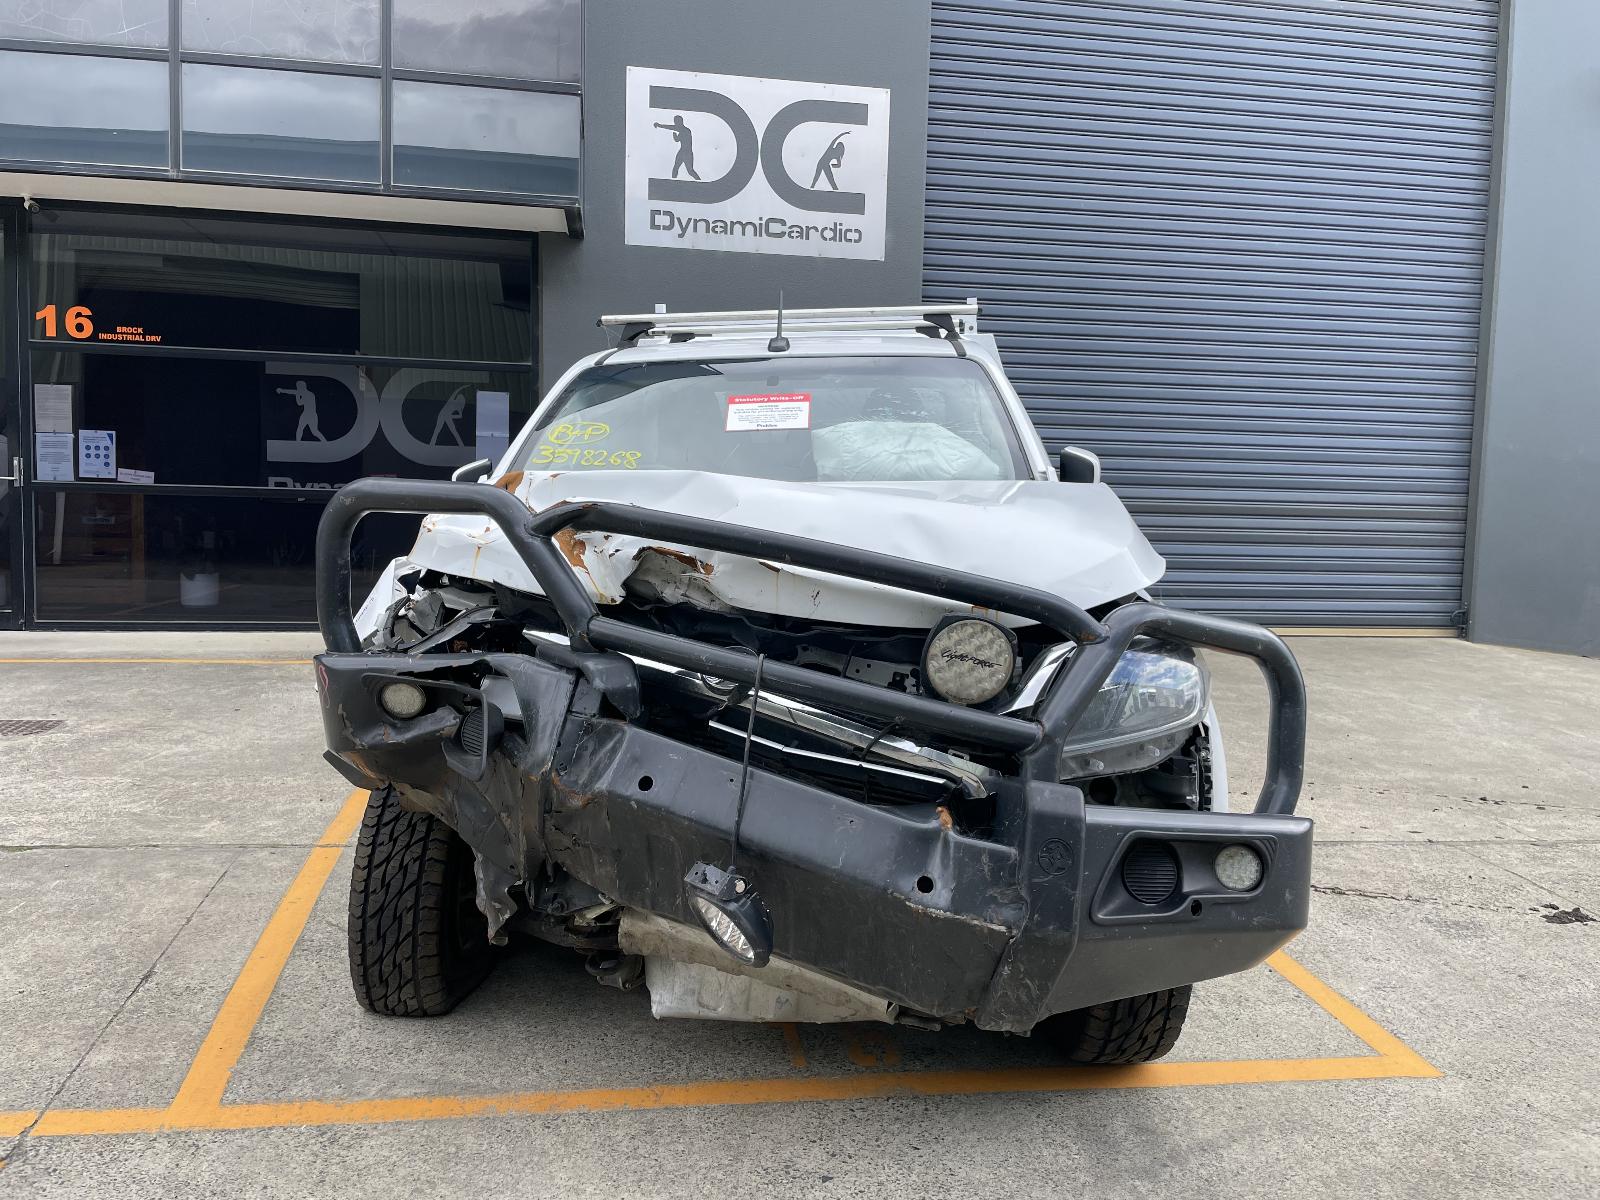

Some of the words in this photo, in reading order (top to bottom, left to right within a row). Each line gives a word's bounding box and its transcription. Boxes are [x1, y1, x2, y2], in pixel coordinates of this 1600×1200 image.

[649, 209, 863, 244] DynamiCardio
[35, 304, 94, 339] 16
[116, 326, 144, 334] BROCK
[98, 333, 144, 342] INDUSTRIAL
